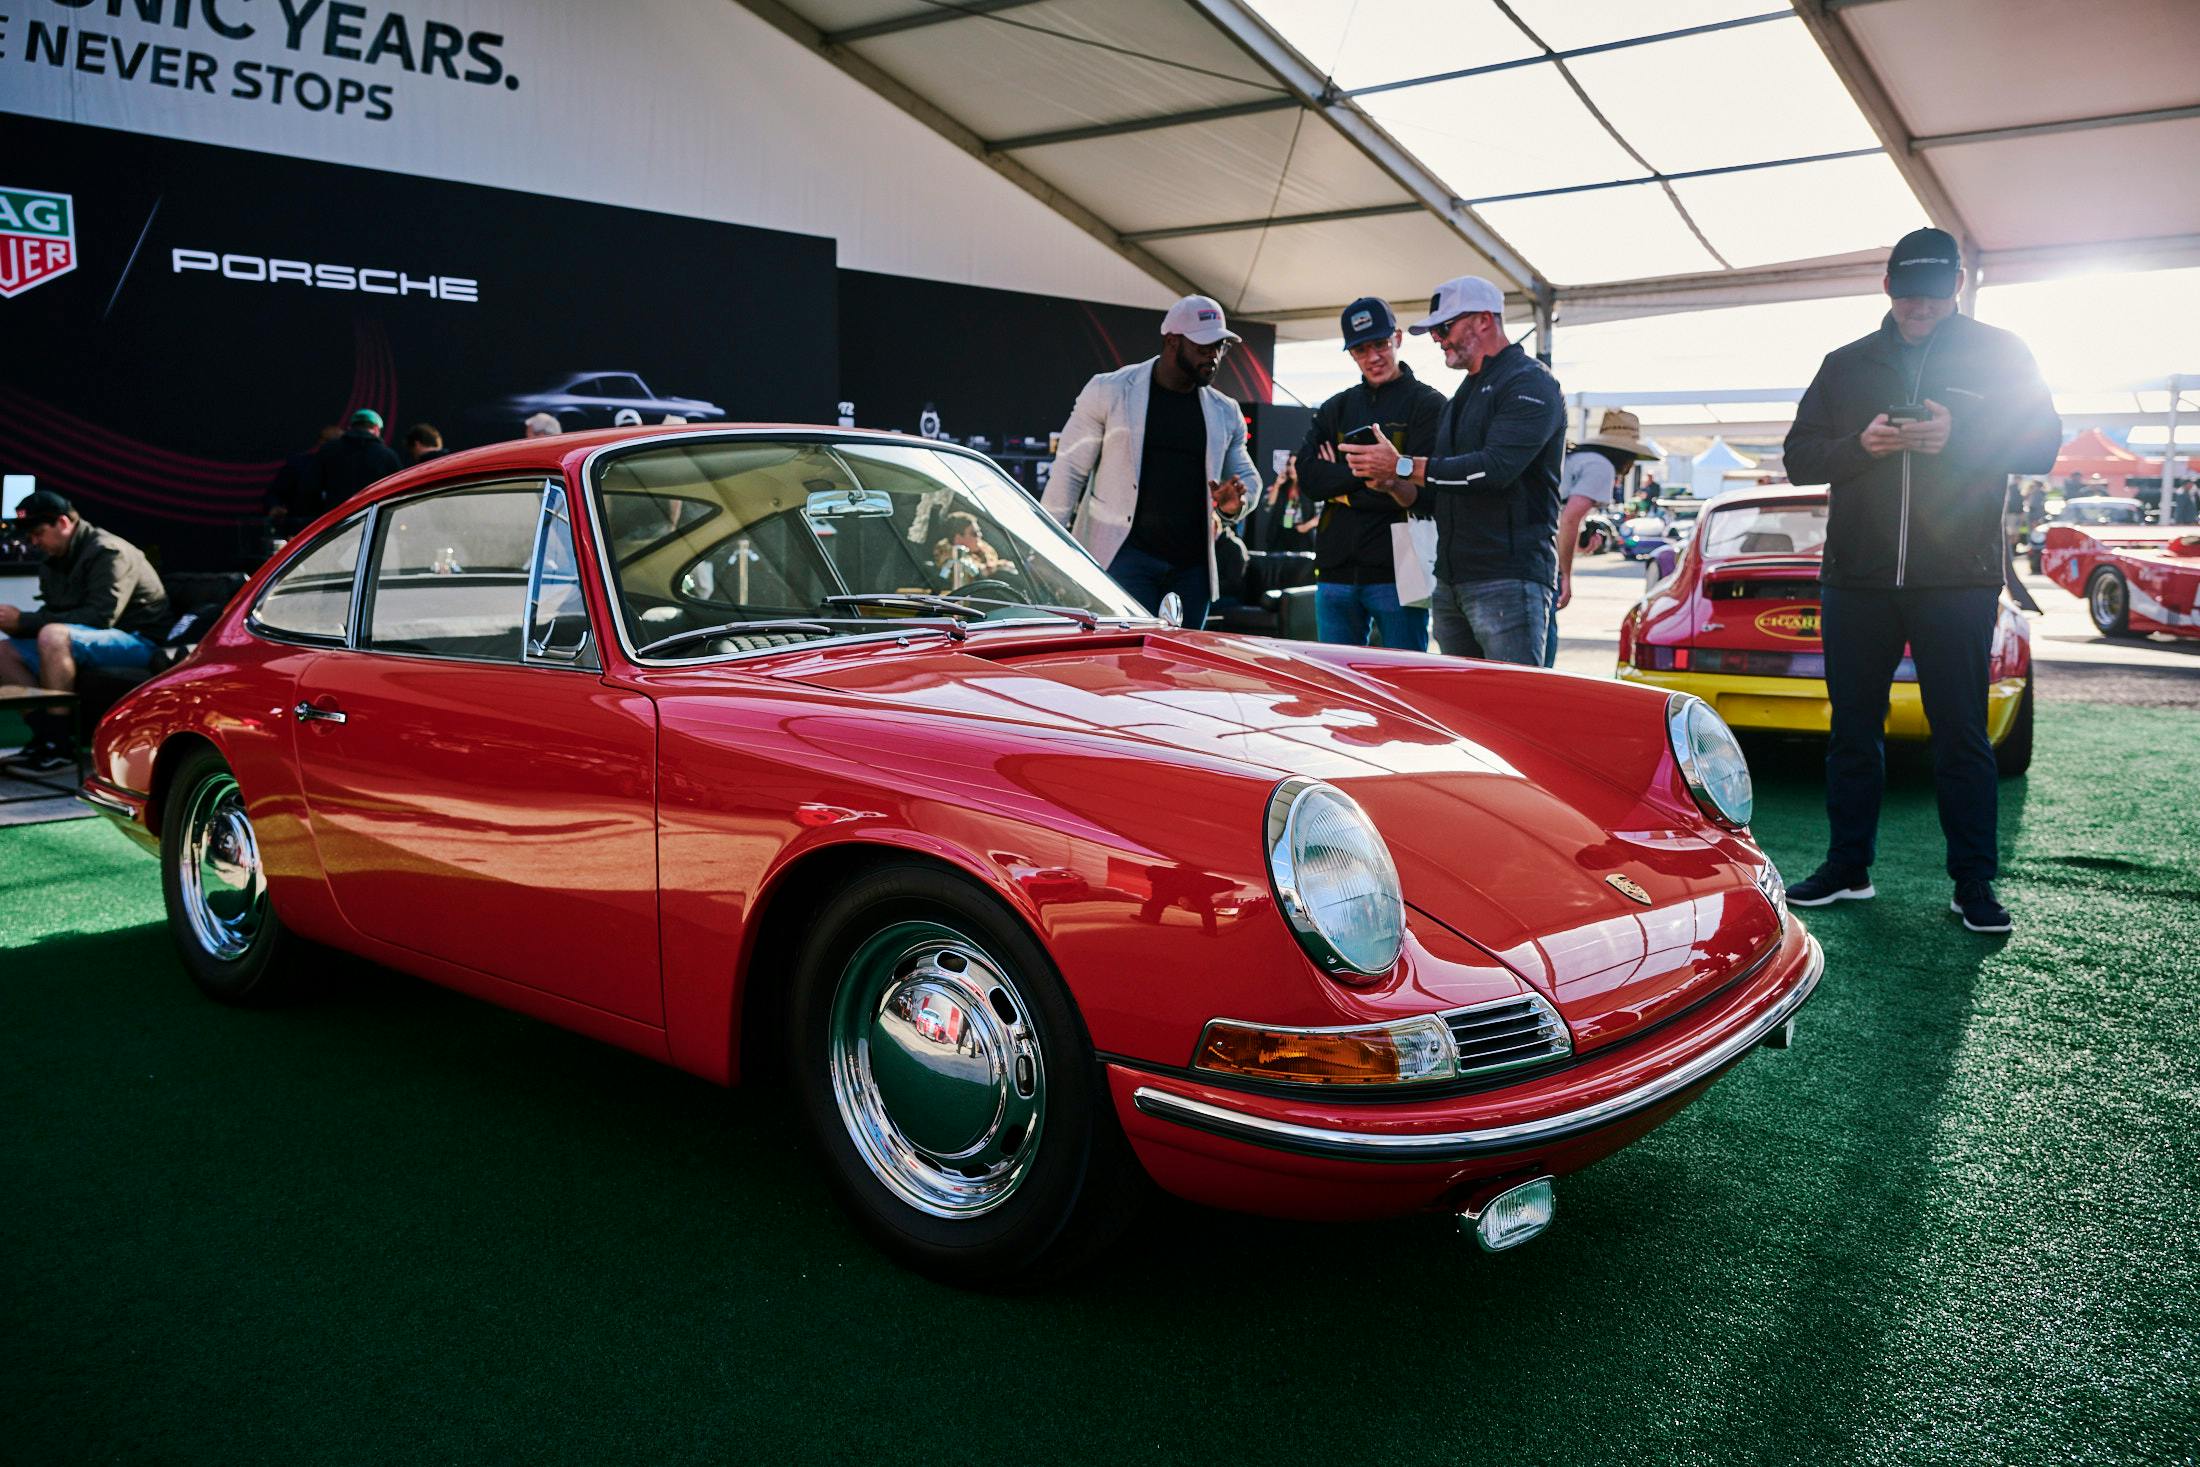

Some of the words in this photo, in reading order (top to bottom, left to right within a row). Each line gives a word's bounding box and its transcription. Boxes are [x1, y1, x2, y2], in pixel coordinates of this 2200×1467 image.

[25, 20, 217, 94] NEVER
[231, 60, 394, 122] STOPS
[51, 0, 256, 40] IC
[278, 0, 521, 91] YEARS.
[172, 248, 479, 303] PORSCHE
